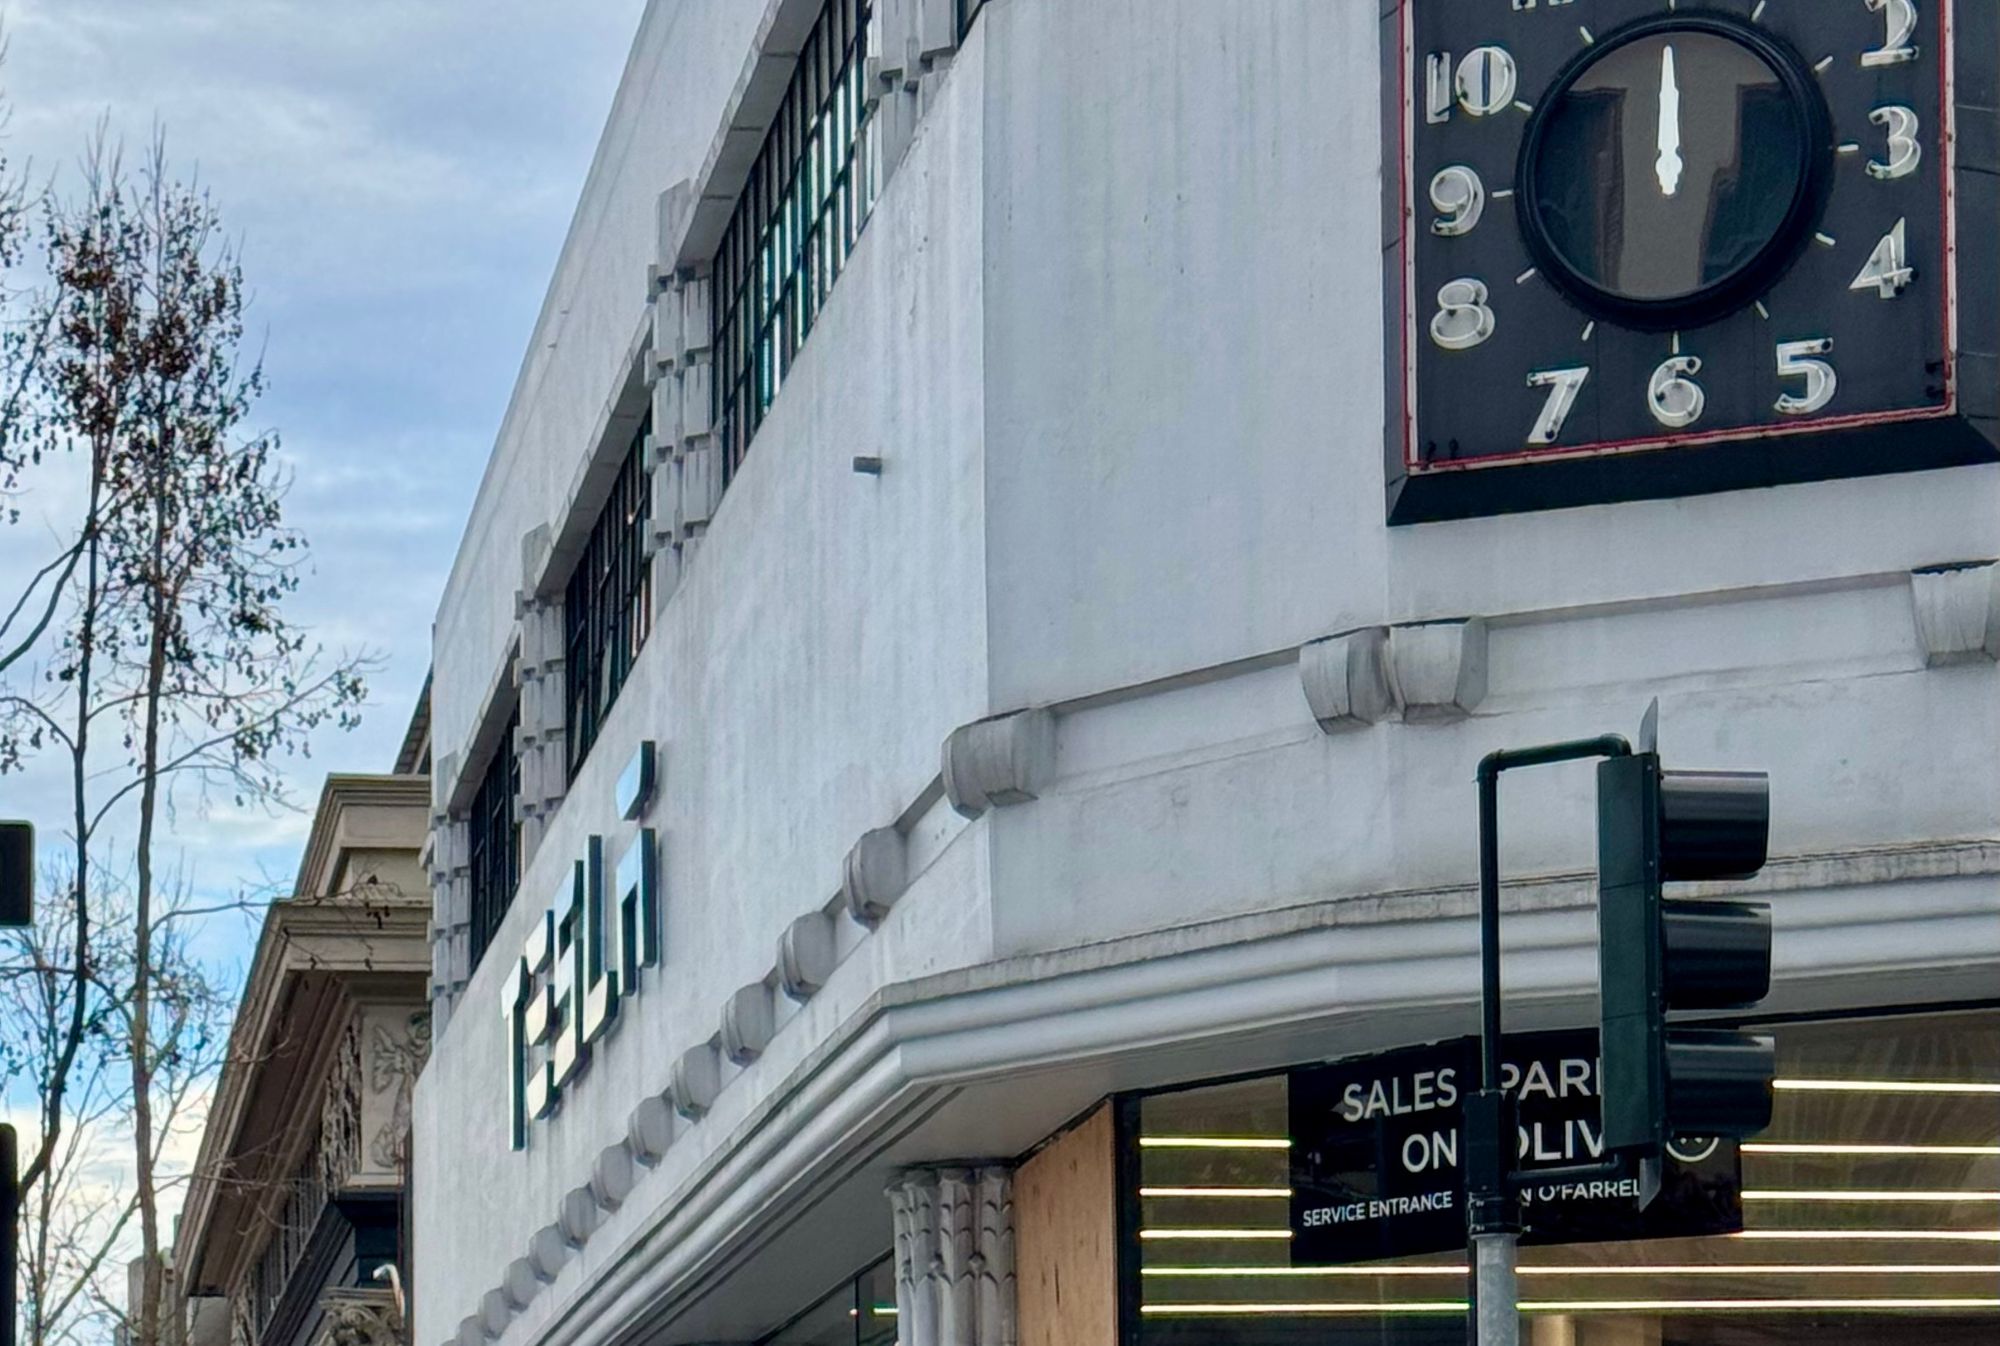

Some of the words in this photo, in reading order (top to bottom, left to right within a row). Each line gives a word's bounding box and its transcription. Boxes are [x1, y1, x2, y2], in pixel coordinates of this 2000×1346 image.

[1861, 0, 1919, 67] 2
[1426, 46, 1517, 124] 10
[1865, 106, 1921, 180] 3
[1430, 165, 1485, 236] 9
[1849, 217, 1919, 298] 4
[1430, 277, 1495, 349] 8
[1526, 366, 1590, 443] 7
[1648, 356, 1704, 428] 6
[1773, 337, 1837, 413] 5
[1343, 1068, 1457, 1122] SALES
[1501, 1057, 1600, 1101] PAR
[1402, 1128, 1457, 1173] ON
[1303, 1203, 1366, 1227] SERVICE
[1368, 1191, 1453, 1218] ENTRANCE
[1538, 1178, 1641, 1202] O'FARREL
